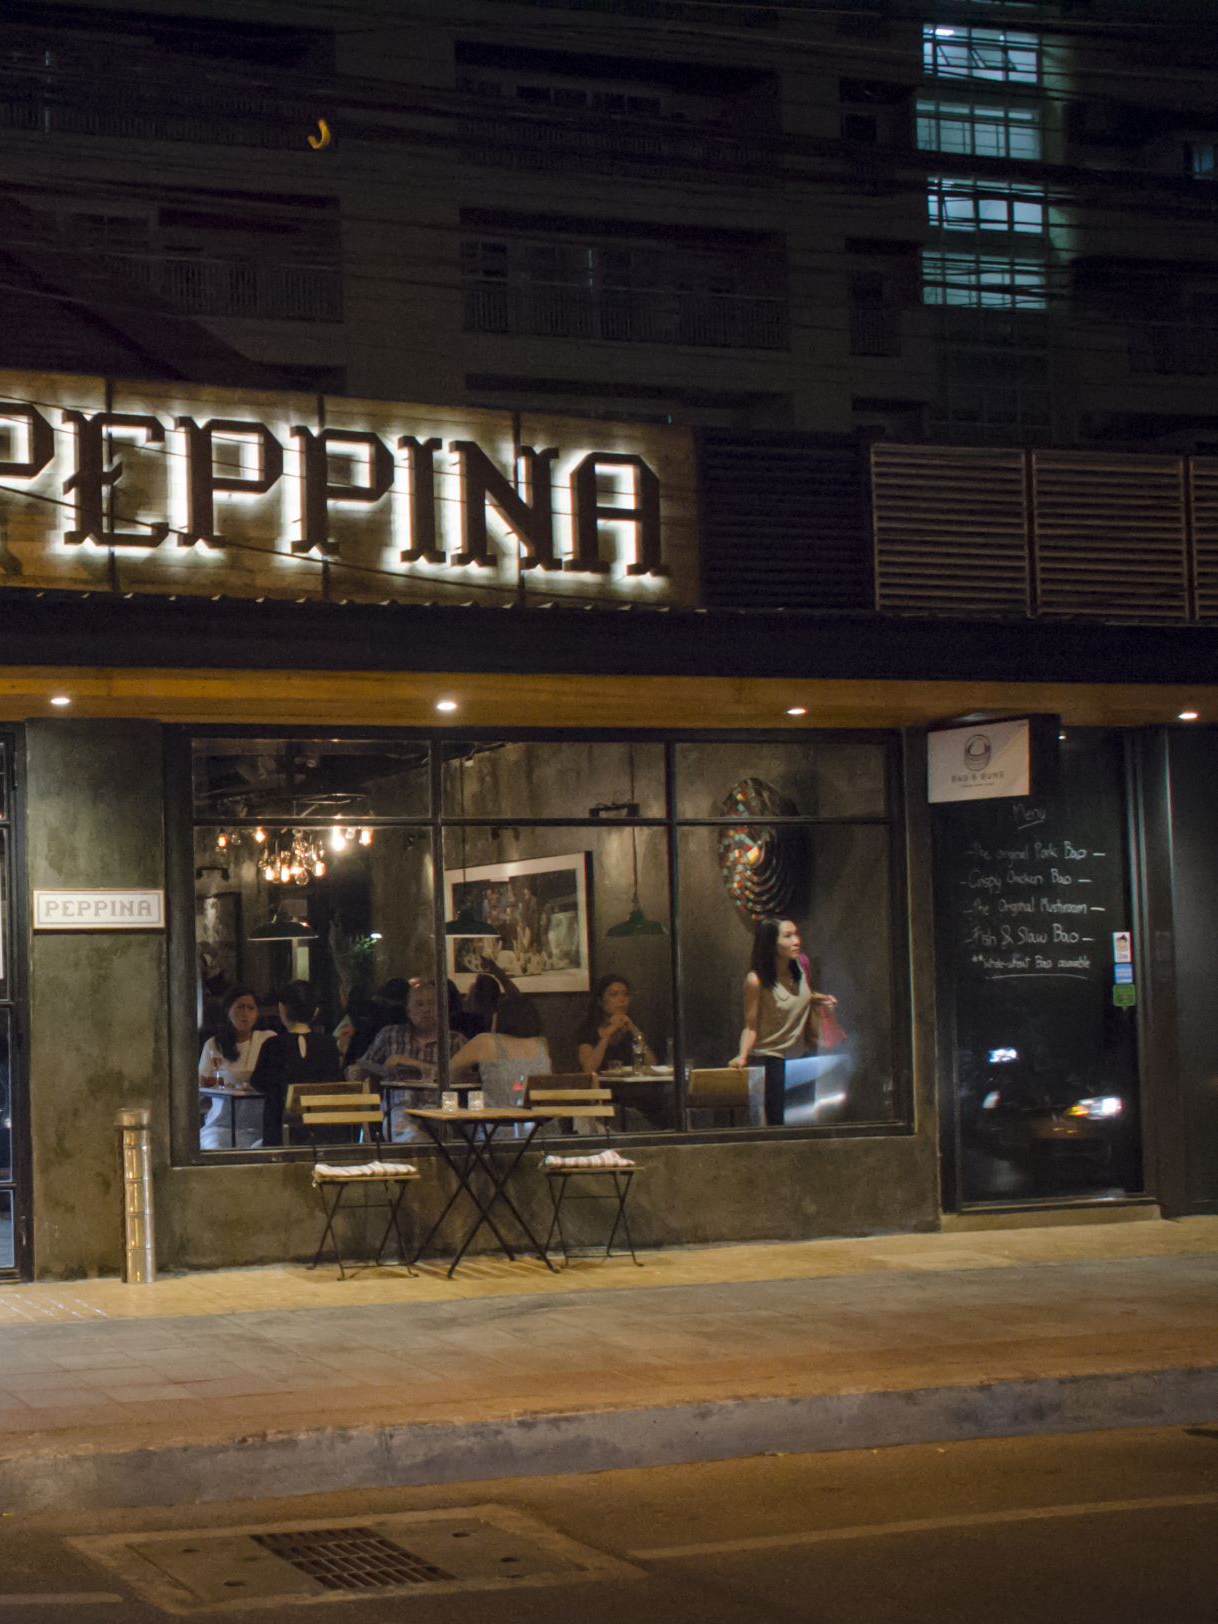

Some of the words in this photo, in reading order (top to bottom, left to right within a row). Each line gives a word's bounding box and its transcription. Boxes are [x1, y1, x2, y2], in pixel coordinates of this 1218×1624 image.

[1063, 840, 1088, 861] Bao
[1050, 867, 1073, 886] Bao
[44, 900, 153, 918] PEPPINA
[1052, 922, 1080, 944] Bao
